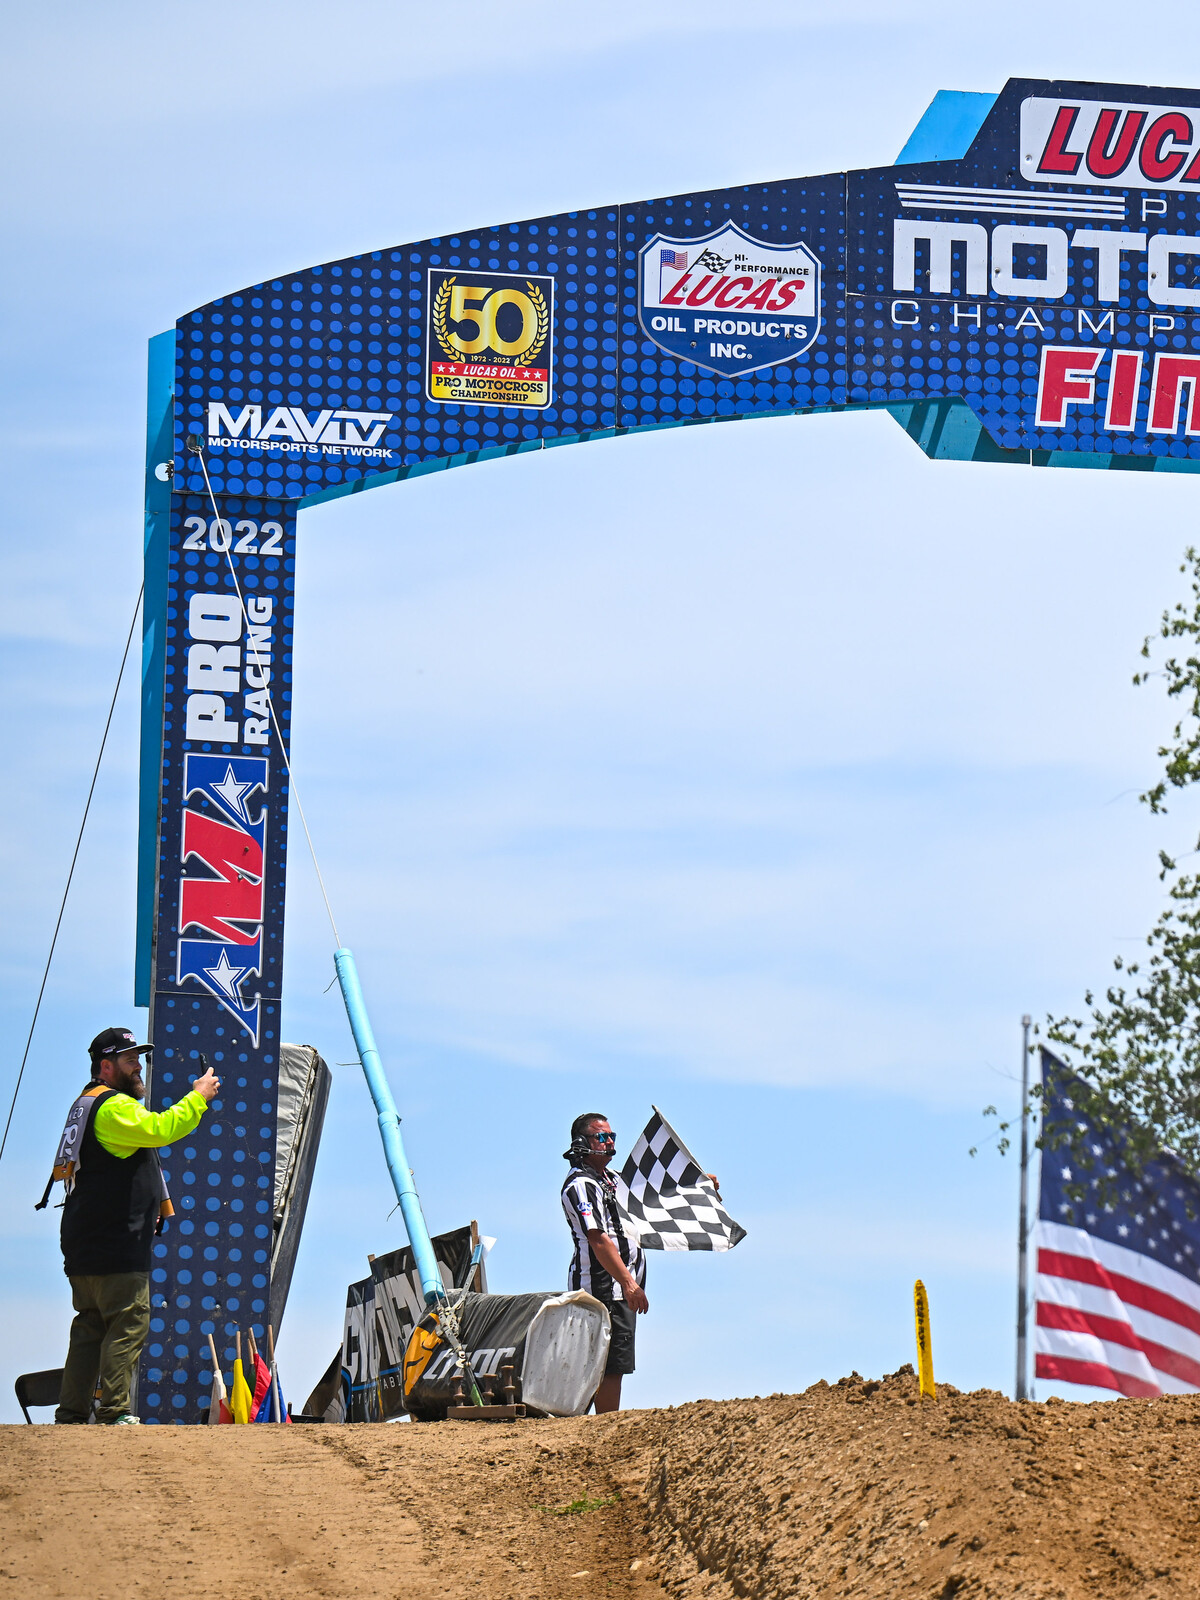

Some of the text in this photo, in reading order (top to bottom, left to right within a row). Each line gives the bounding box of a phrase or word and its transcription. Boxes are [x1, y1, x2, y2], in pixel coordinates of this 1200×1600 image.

[734, 264, 810, 276] PERFORMANCE
[660, 273, 806, 311] LUCAS
[446, 285, 539, 357] 50
[651, 316, 808, 340] OIL PRODUCTS
[463, 365, 517, 378] LUCAS OIL
[471, 355, 487, 363] 1972
[493, 356, 511, 364] 2022
[435, 376, 543, 393] PRO MOTOCROSS
[450, 389, 529, 402] CHAMPIONSHIP
[208, 437, 393, 459] MOTORSPORTS NETWORK
[182, 516, 284, 556] 2022
[185, 592, 243, 744] PRO
[244, 596, 273, 746] RACING
[176, 752, 269, 1049] AMA
